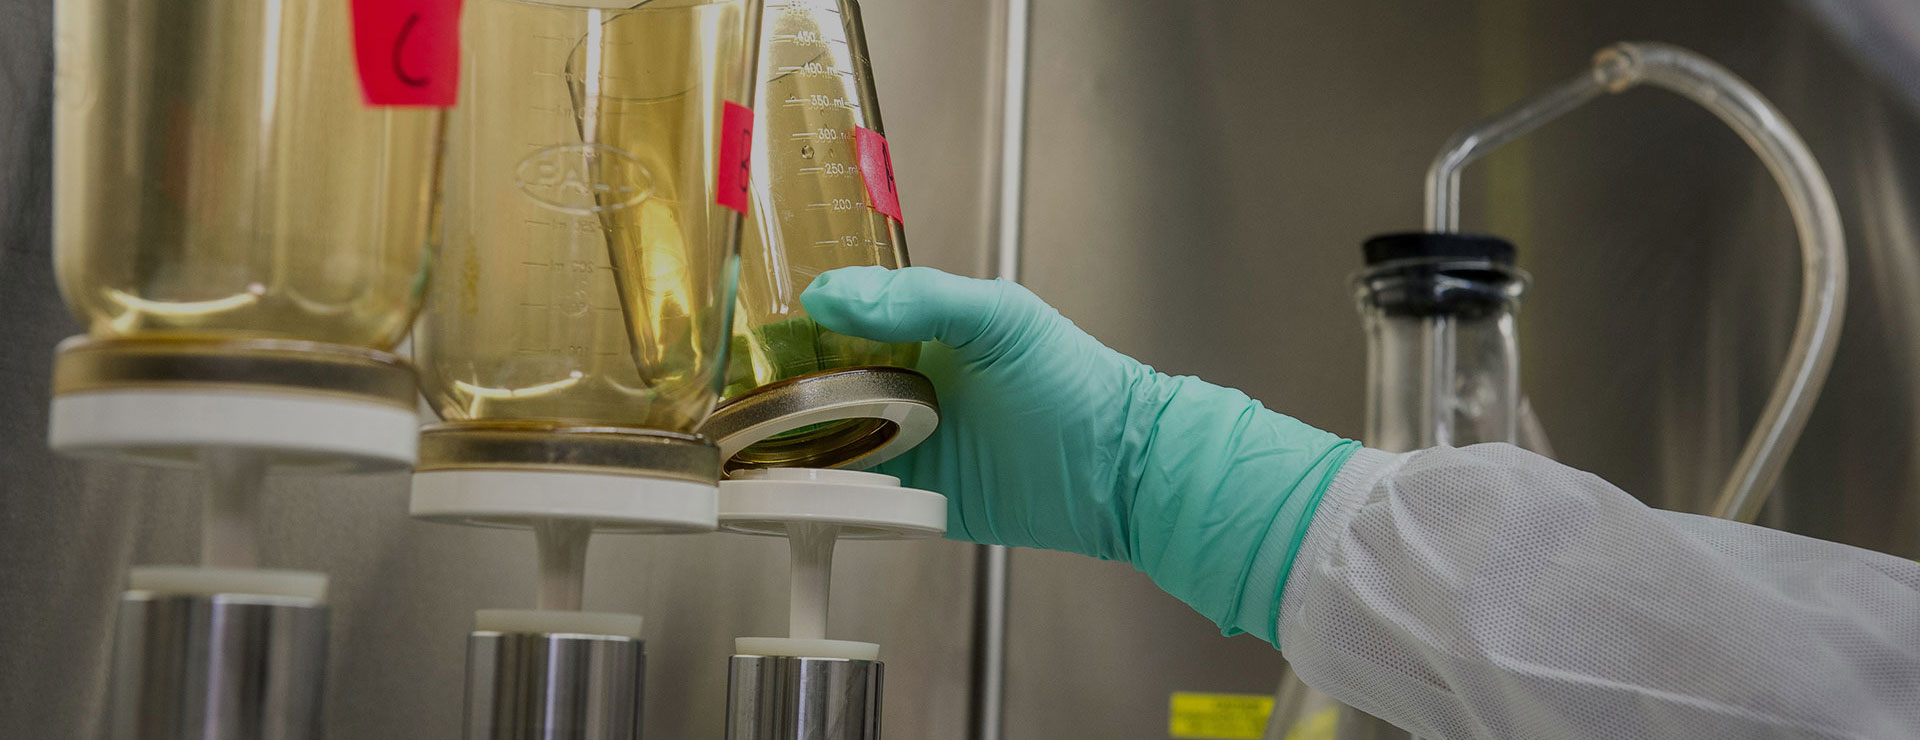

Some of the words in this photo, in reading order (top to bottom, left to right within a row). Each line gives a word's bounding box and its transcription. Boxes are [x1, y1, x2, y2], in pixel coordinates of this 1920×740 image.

[391, 13, 430, 88] C
[803, 62, 823, 75] 400
[810, 94, 830, 107] 350
[833, 96, 845, 106] ml
[817, 127, 837, 140] 300
[824, 163, 844, 175] 250
[832, 198, 852, 211] 200
[840, 235, 859, 247] 150
